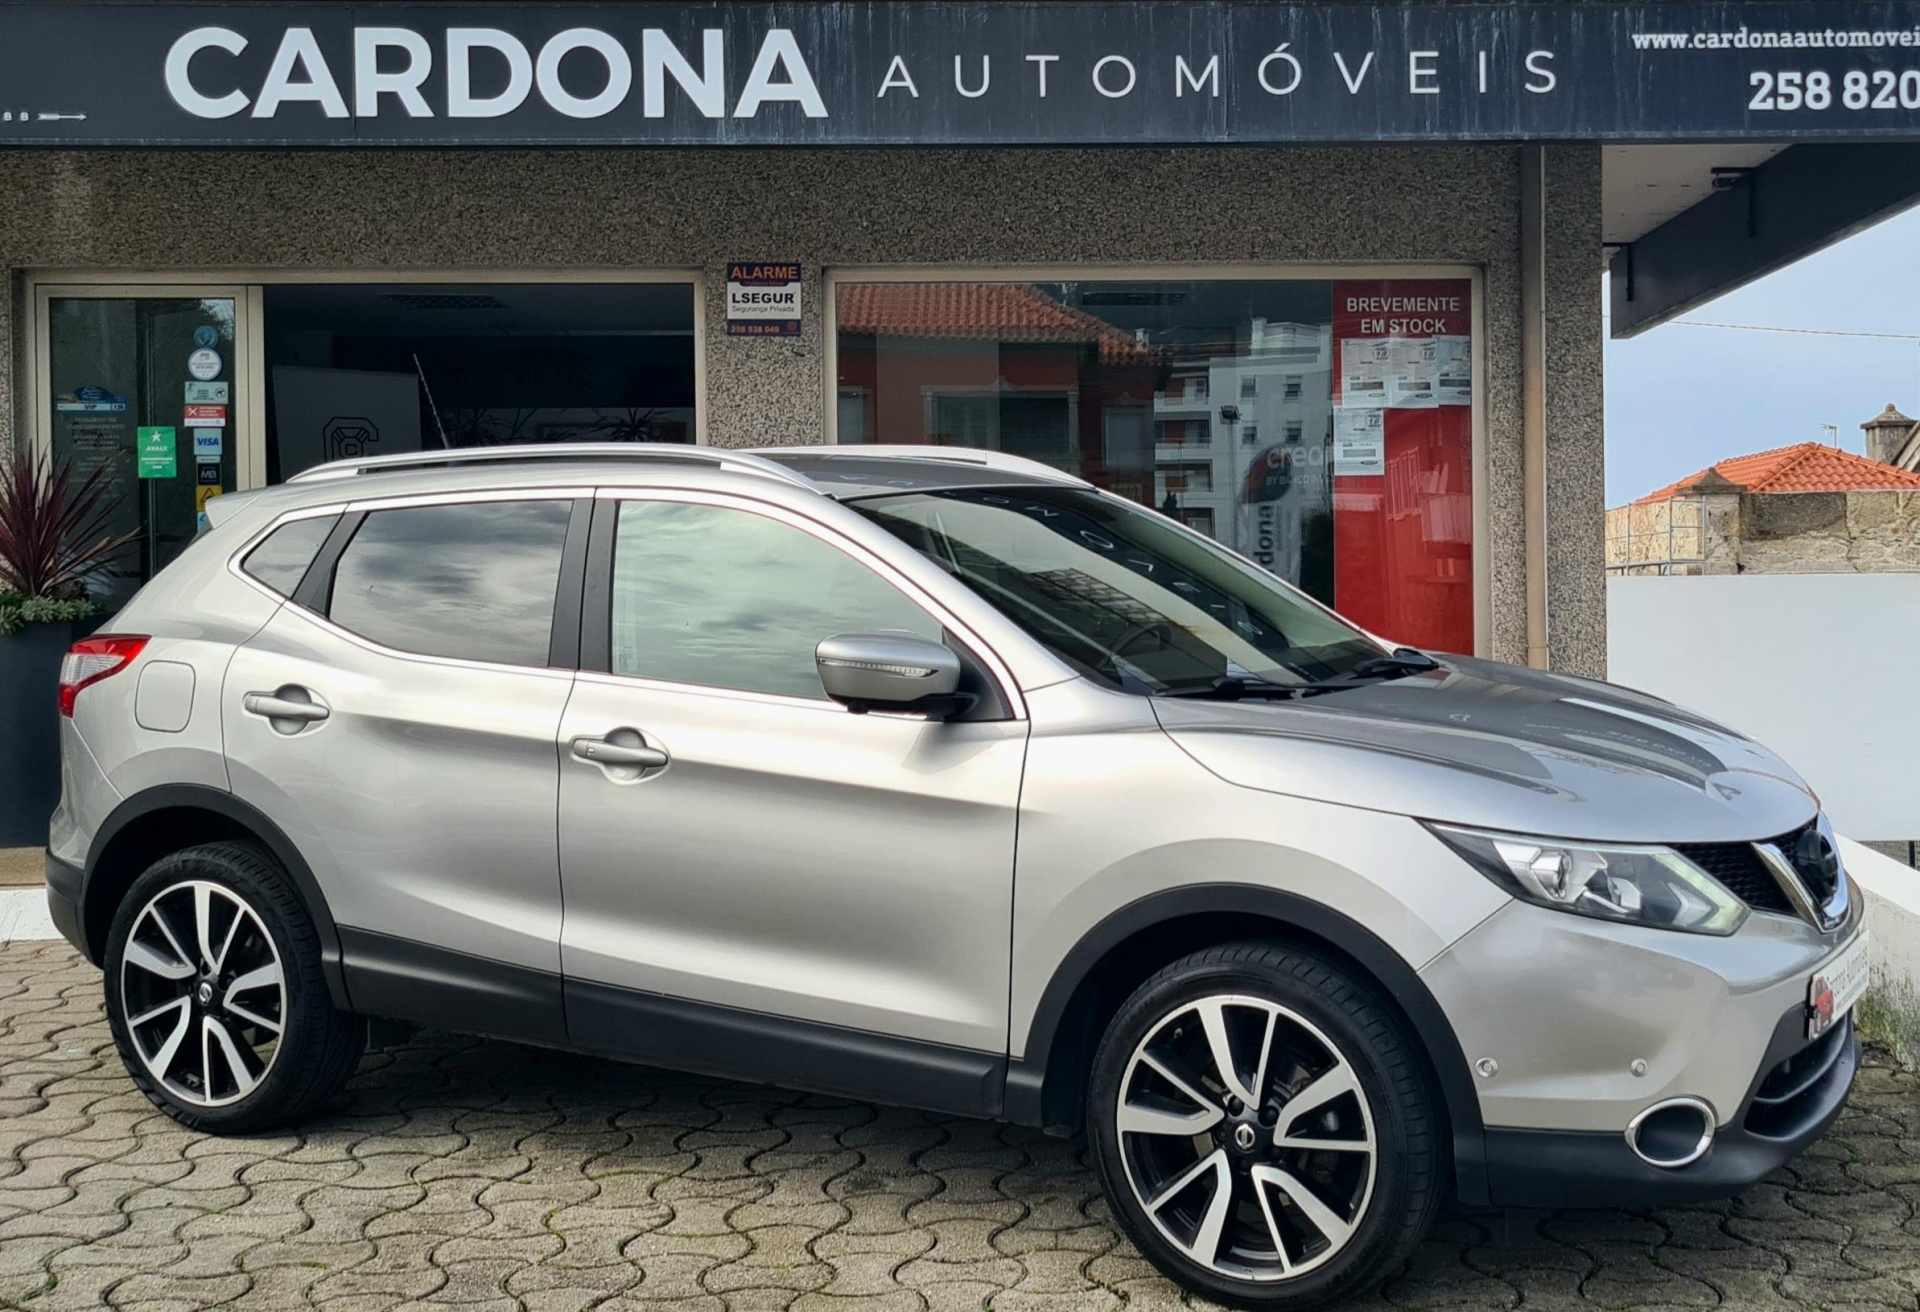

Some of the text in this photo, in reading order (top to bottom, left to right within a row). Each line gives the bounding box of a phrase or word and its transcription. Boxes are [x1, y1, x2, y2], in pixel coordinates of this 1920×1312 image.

[163, 26, 1558, 120] CARDONA AUTOMÓVEIS
[1748, 70, 1920, 110] 258 820
[730, 266, 798, 279] ALARME
[732, 292, 794, 304] LSEGUR
[1347, 297, 1460, 312] BREVEMENTE
[1361, 318, 1446, 333] EM STOCK
[197, 438, 219, 446] VISA
